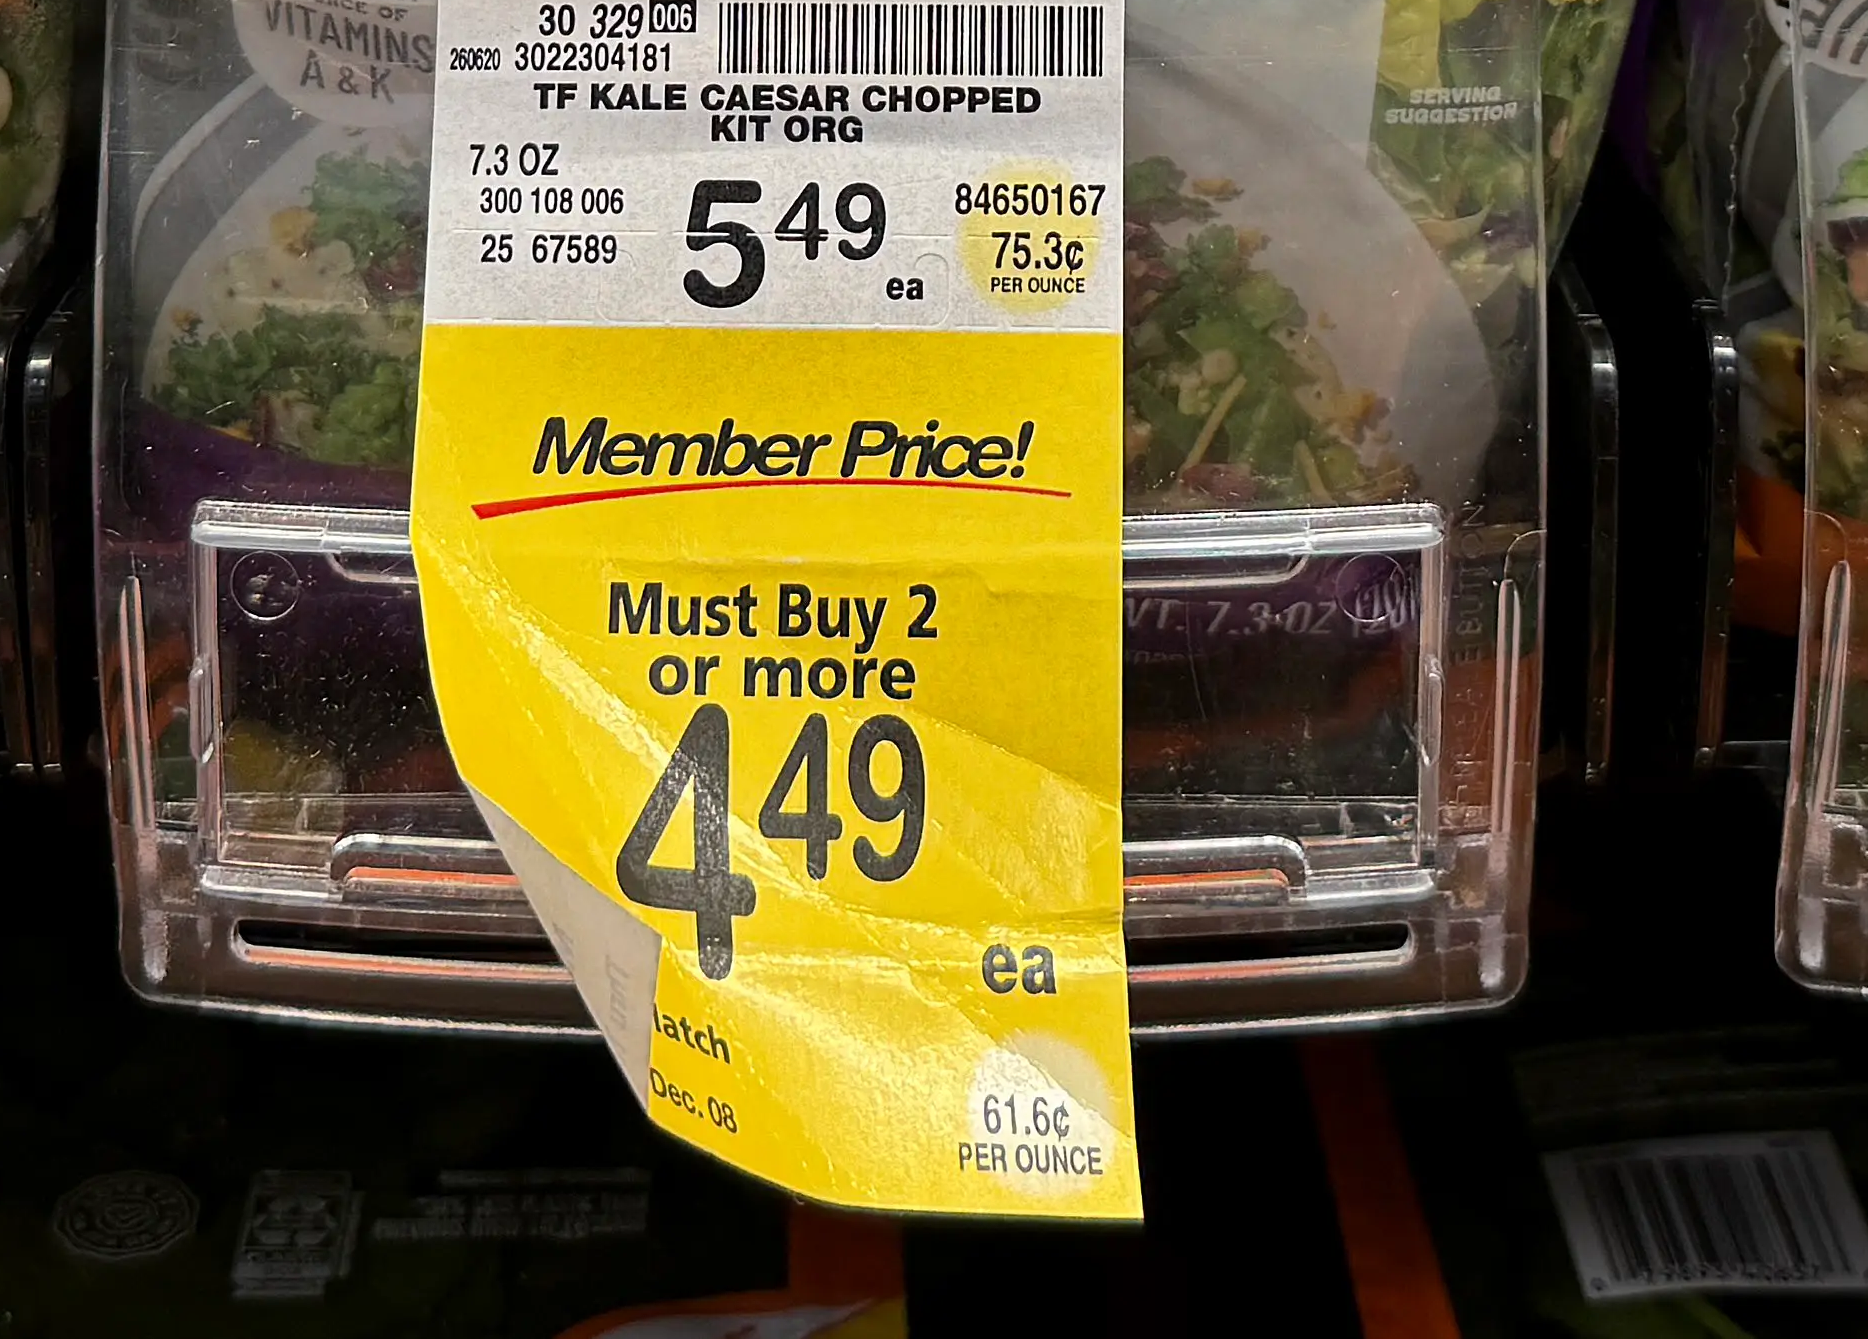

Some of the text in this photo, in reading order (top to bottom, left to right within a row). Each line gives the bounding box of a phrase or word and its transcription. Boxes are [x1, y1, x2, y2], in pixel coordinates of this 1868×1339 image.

[265, 0, 434, 73] VITAMINS
[533, 83, 1041, 114] TF KALE CAESAR CHOPPED
[1409, 86, 1501, 105] SERVING
[1385, 102, 1518, 124] SUGGESTION
[711, 116, 864, 144] KIT ORG
[470, 145, 560, 176] 7.3 OZ
[954, 184, 1105, 215] 84650167
[480, 235, 617, 264] 25 67589
[991, 232, 1084, 270] 75.3¢
[983, 1093, 1070, 1141] 61.6¢
